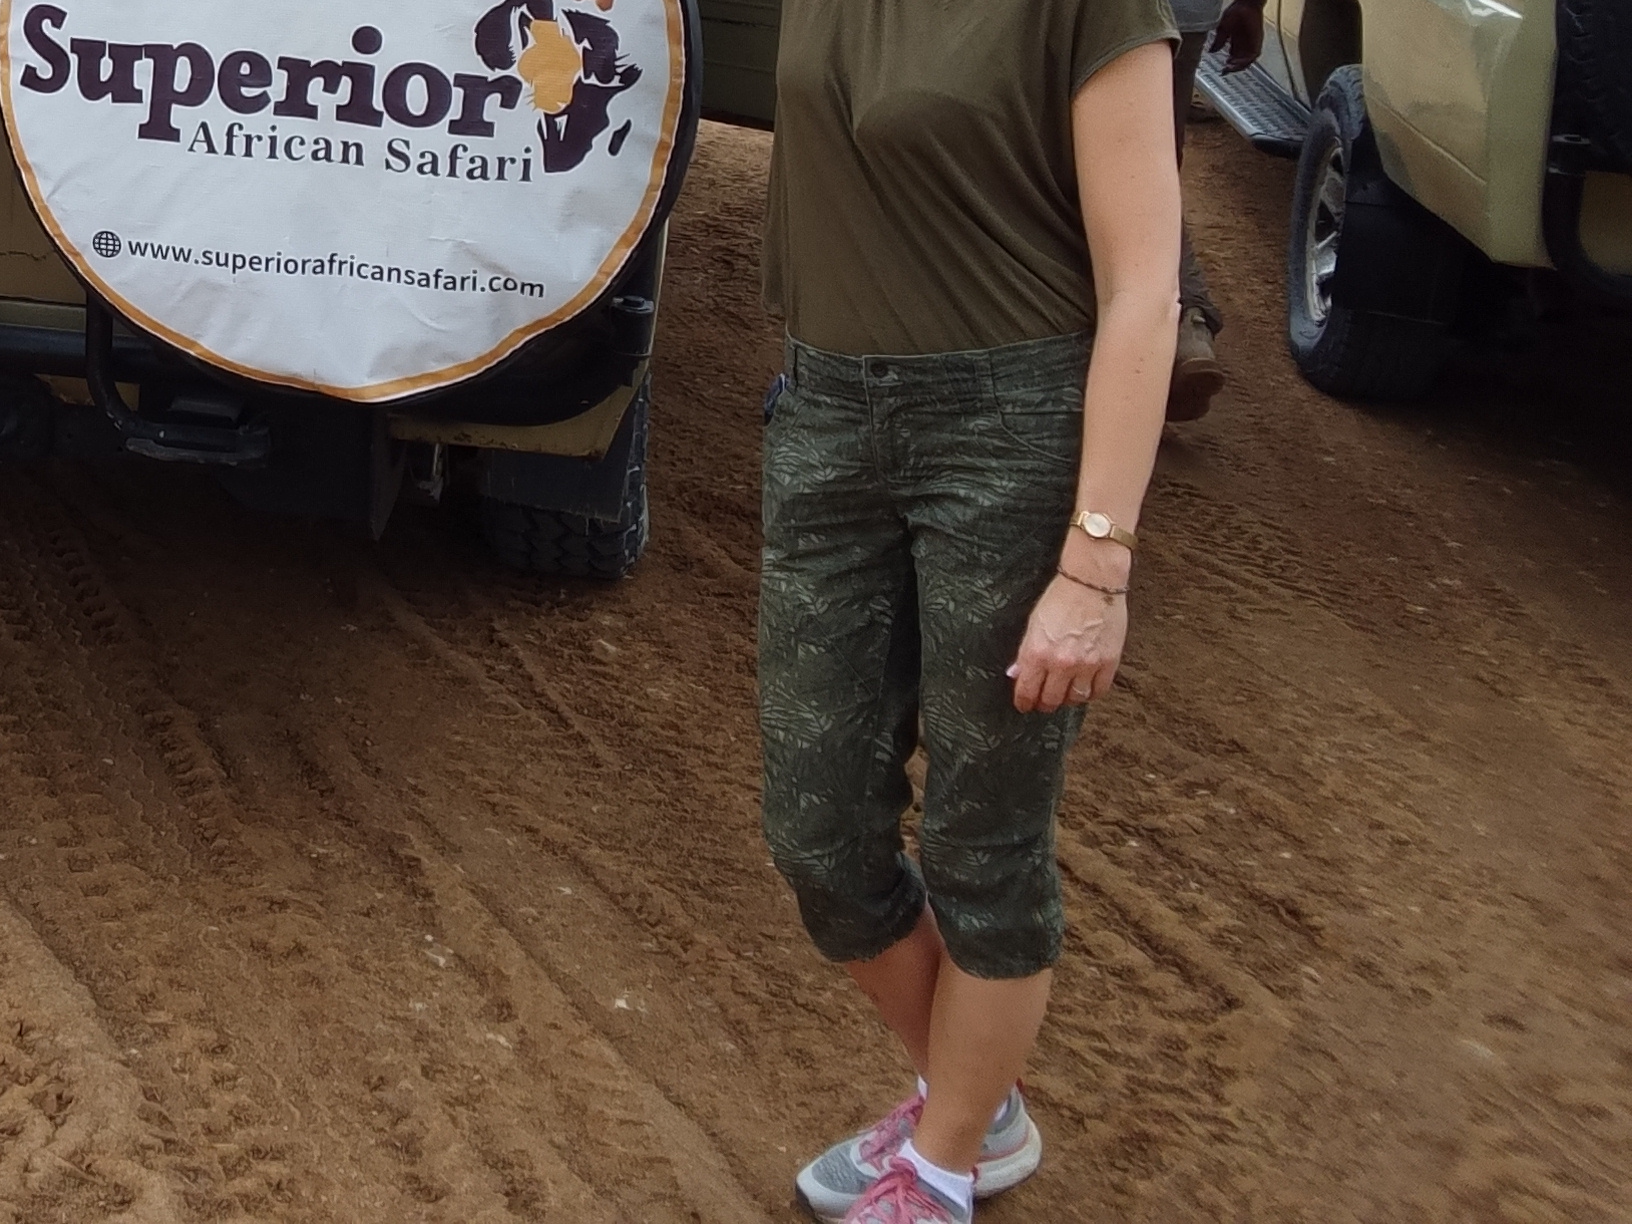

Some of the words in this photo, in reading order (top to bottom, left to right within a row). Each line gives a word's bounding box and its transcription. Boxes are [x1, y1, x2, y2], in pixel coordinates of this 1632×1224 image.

[19, 2, 523, 143] Superior
[187, 120, 366, 168] African
[384, 137, 533, 182] Safari
[126, 235, 546, 300] www.superiorafricansafari.com
